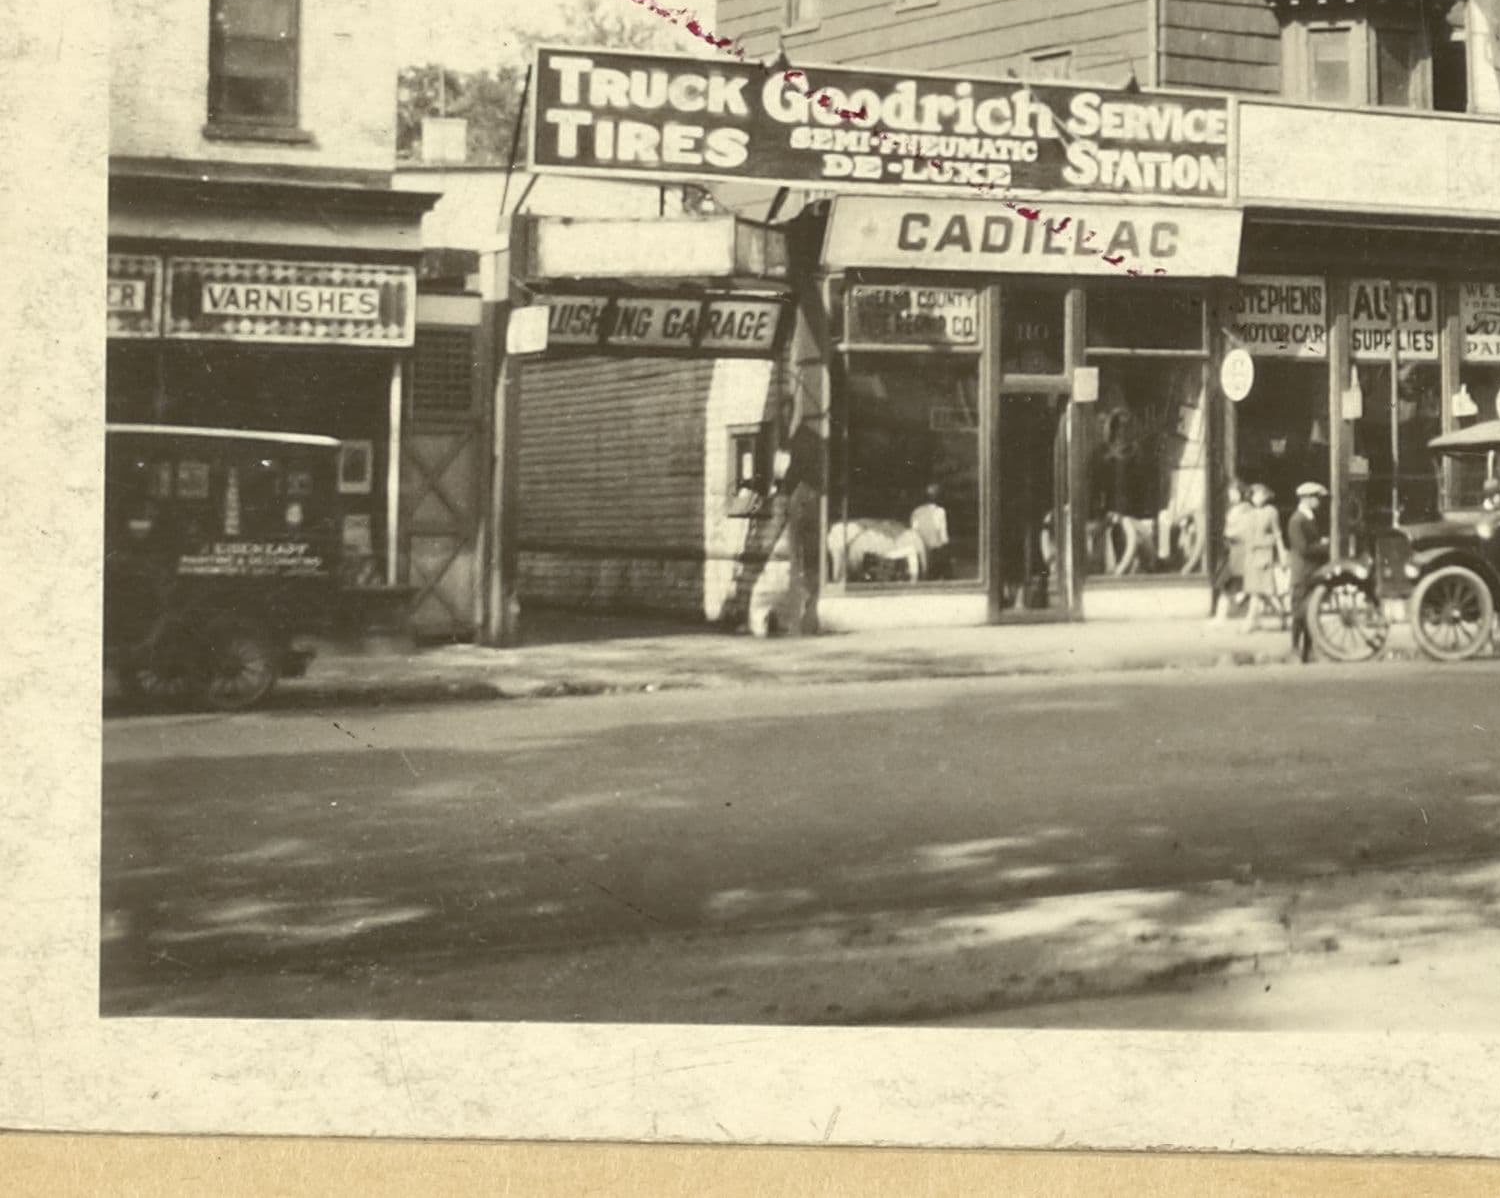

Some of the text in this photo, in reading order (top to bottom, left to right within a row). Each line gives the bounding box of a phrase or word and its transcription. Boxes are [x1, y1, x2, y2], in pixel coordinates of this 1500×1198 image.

[549, 56, 749, 116] TRUCK
[762, 70, 1060, 138] Goodrich
[1066, 92, 1227, 144] SERVICE
[546, 108, 750, 168] TIRES
[790, 126, 1038, 163] SEMI-PNEUMATIC
[1062, 139, 1227, 192] STATION
[897, 212, 1180, 258] CADILLAC
[207, 286, 378, 315] VARNISHES
[1236, 285, 1322, 315] STEPHENS
[1353, 284, 1433, 322] AUTO
[662, 307, 769, 341] GARAGE
[1231, 323, 1325, 344] MOTOR CAR
[1353, 328, 1434, 352] SUPPLIES
